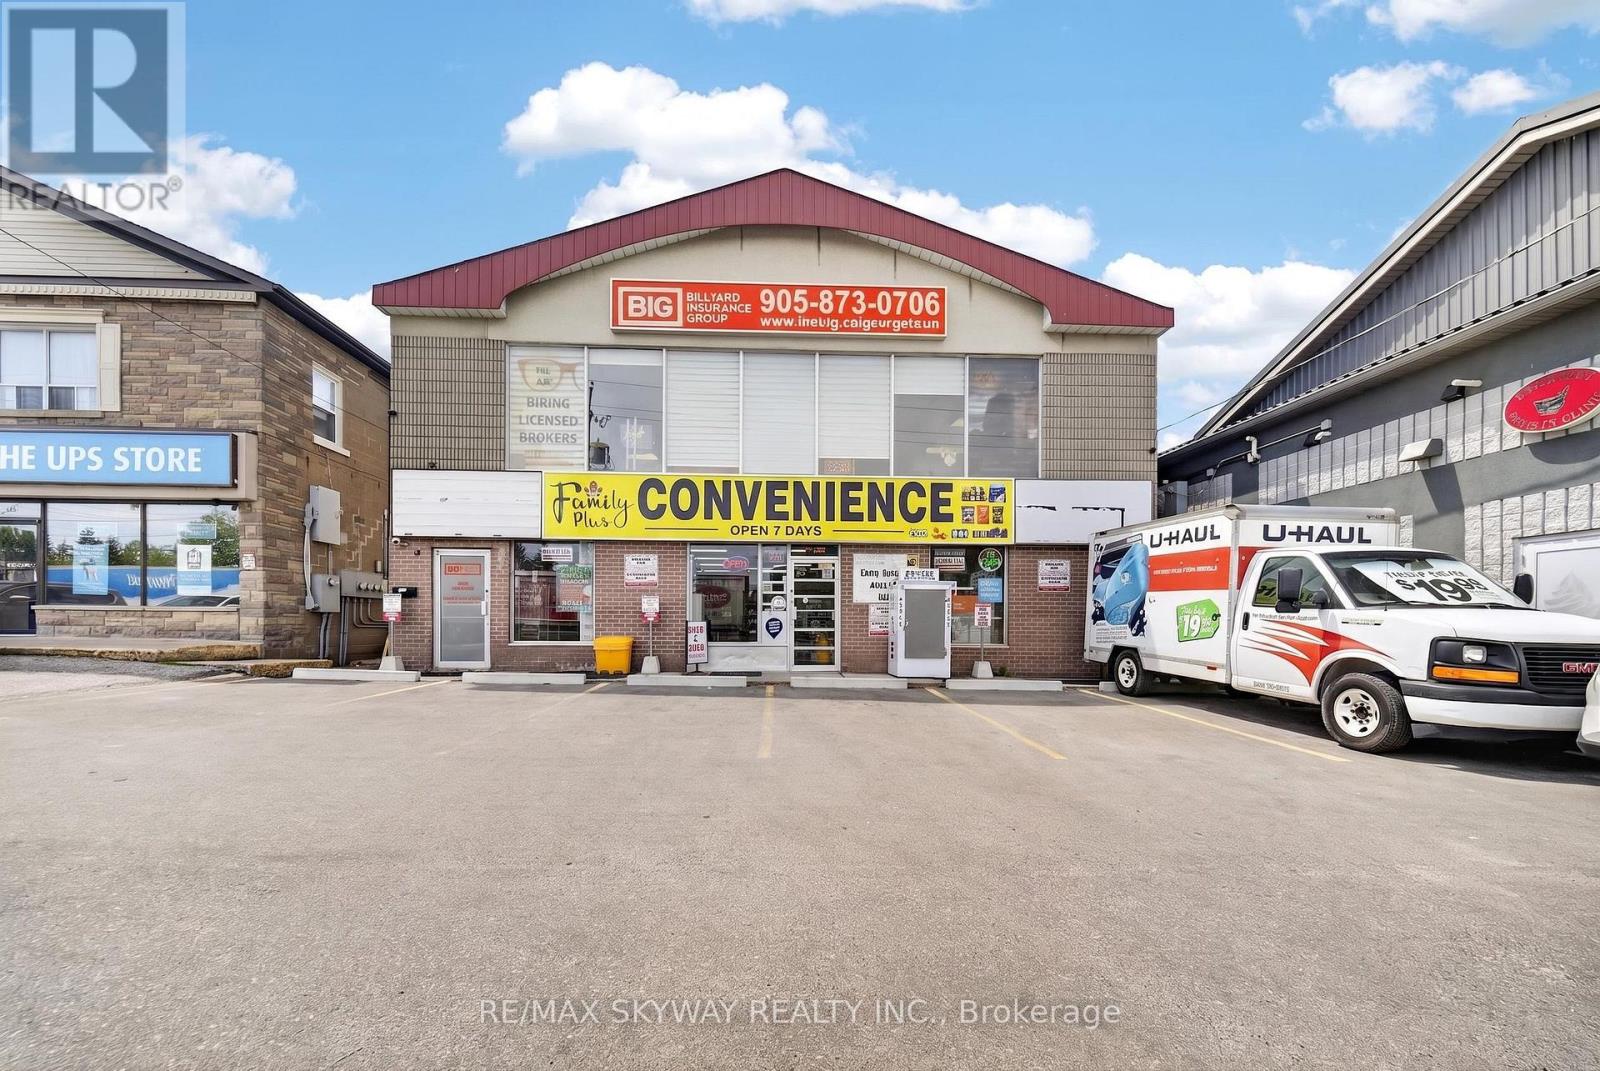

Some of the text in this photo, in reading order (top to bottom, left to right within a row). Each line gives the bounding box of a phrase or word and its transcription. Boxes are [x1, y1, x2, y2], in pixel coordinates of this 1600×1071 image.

[687, 291, 740, 303] BILLYARD
[759, 288, 940, 316] 905-873-0706
[628, 295, 673, 318] BIG
[687, 302, 752, 314] INSURANCE
[687, 312, 729, 324] GROUP
[519, 414, 578, 427] LICENSED
[519, 432, 577, 444] BROKERS
[0, 445, 202, 472] HE UPS STORE
[550, 481, 634, 529] Family
[638, 477, 954, 524] CONVENIENCE
[573, 510, 609, 528] Plus
[730, 525, 822, 537] OPEN 7 DAYS
[1263, 524, 1372, 544] U-HAUL
